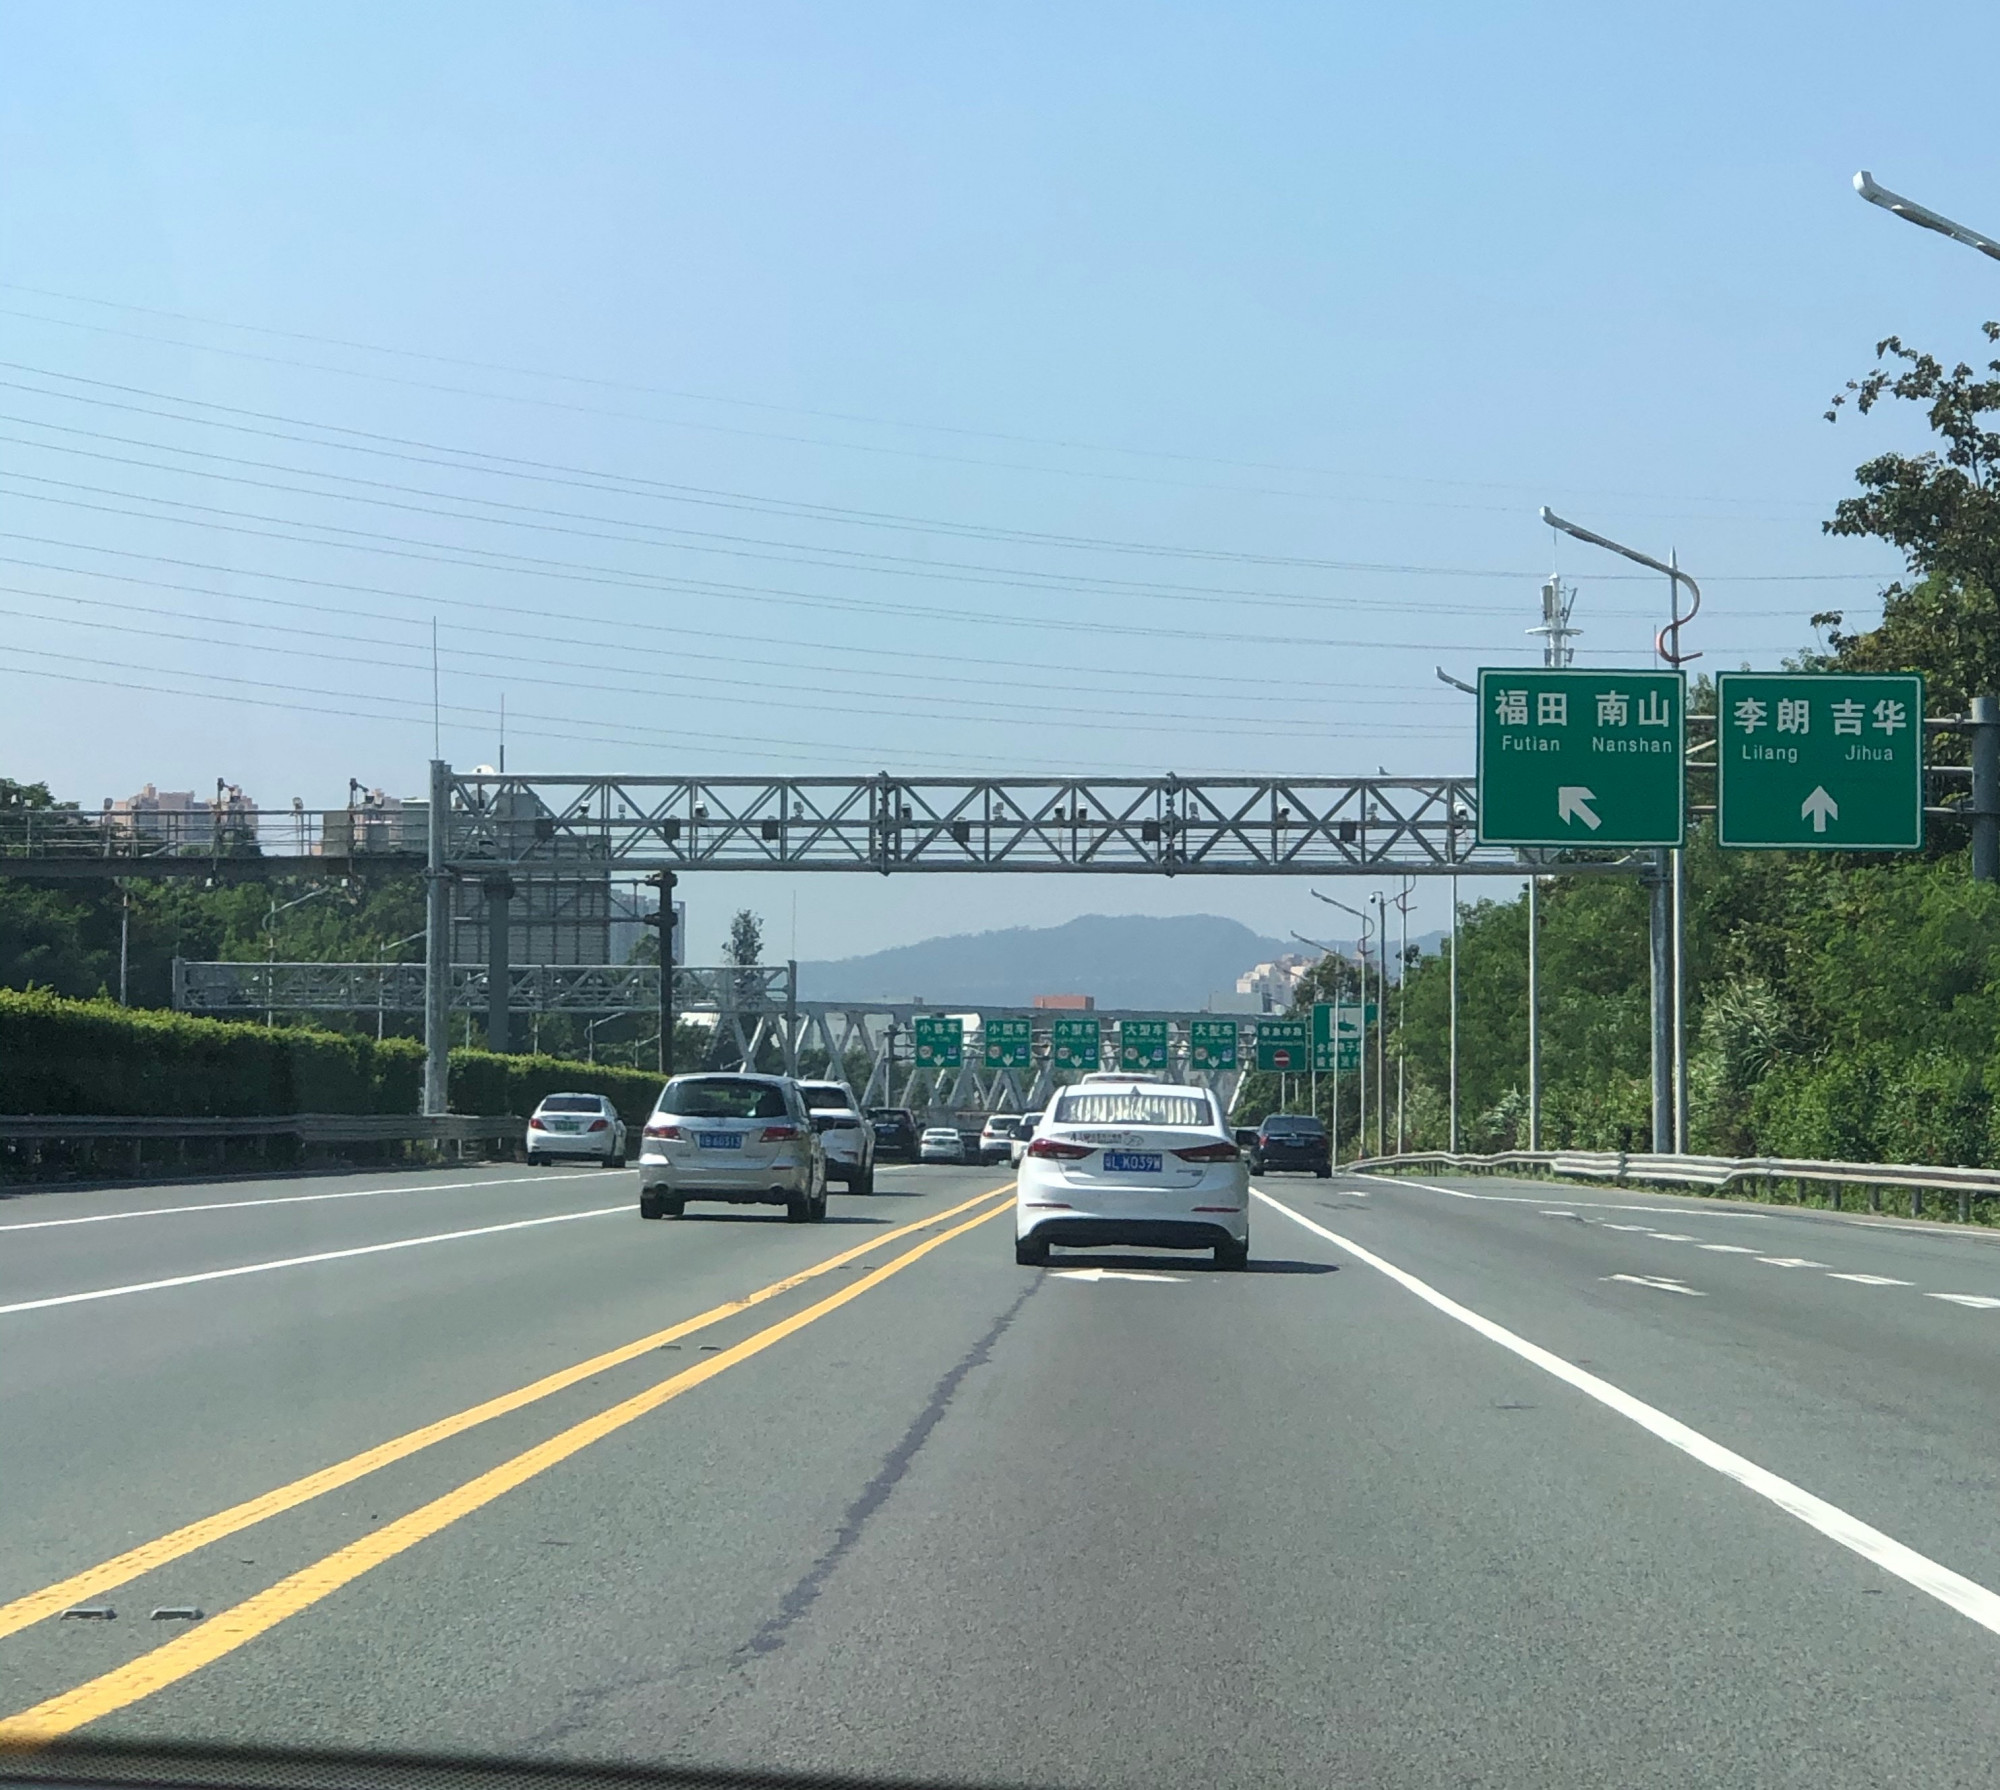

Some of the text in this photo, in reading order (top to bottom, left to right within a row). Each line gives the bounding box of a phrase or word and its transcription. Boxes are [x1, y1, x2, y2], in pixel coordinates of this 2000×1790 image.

[1495, 689, 1669, 727] 福田 南山
[1733, 697, 1907, 736] 李朗 吉华
[1502, 735, 1672, 753] Futian Nanshan
[1742, 744, 1893, 763] Lilang Jihua
[1125, 1023, 1163, 1036] 大型车
[1195, 1023, 1233, 1036] 大型车
